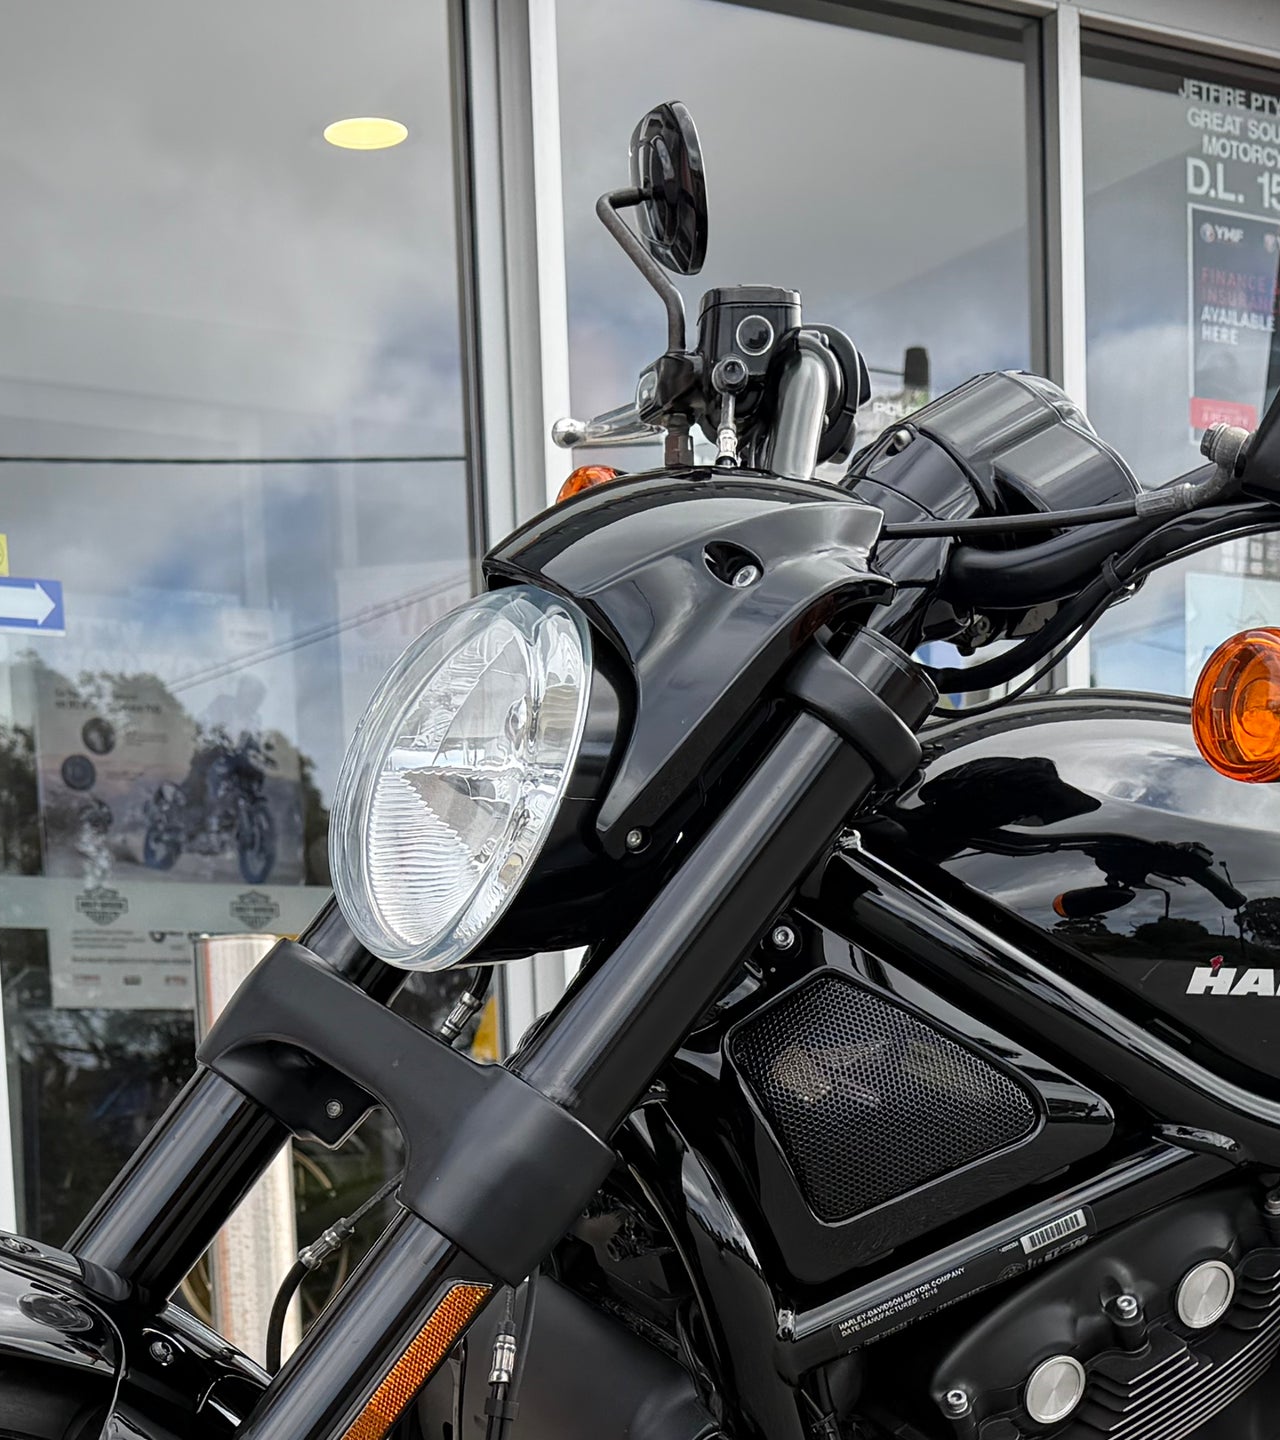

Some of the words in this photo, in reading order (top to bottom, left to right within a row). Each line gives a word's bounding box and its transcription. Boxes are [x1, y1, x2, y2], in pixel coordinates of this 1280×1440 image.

[1178, 78, 1247, 110] JETFIRE
[1186, 107, 1243, 136] GREAT
[1186, 157, 1245, 204] D.L.
[1200, 305, 1276, 332] AVAILABLE
[1200, 323, 1239, 345] HERE
[838, 1294, 904, 1331] HARLEY-DAVIDSON
[904, 1283, 931, 1300] MOTOR
[930, 1266, 966, 1287] COMPANY
[841, 1325, 861, 1338] DATE
